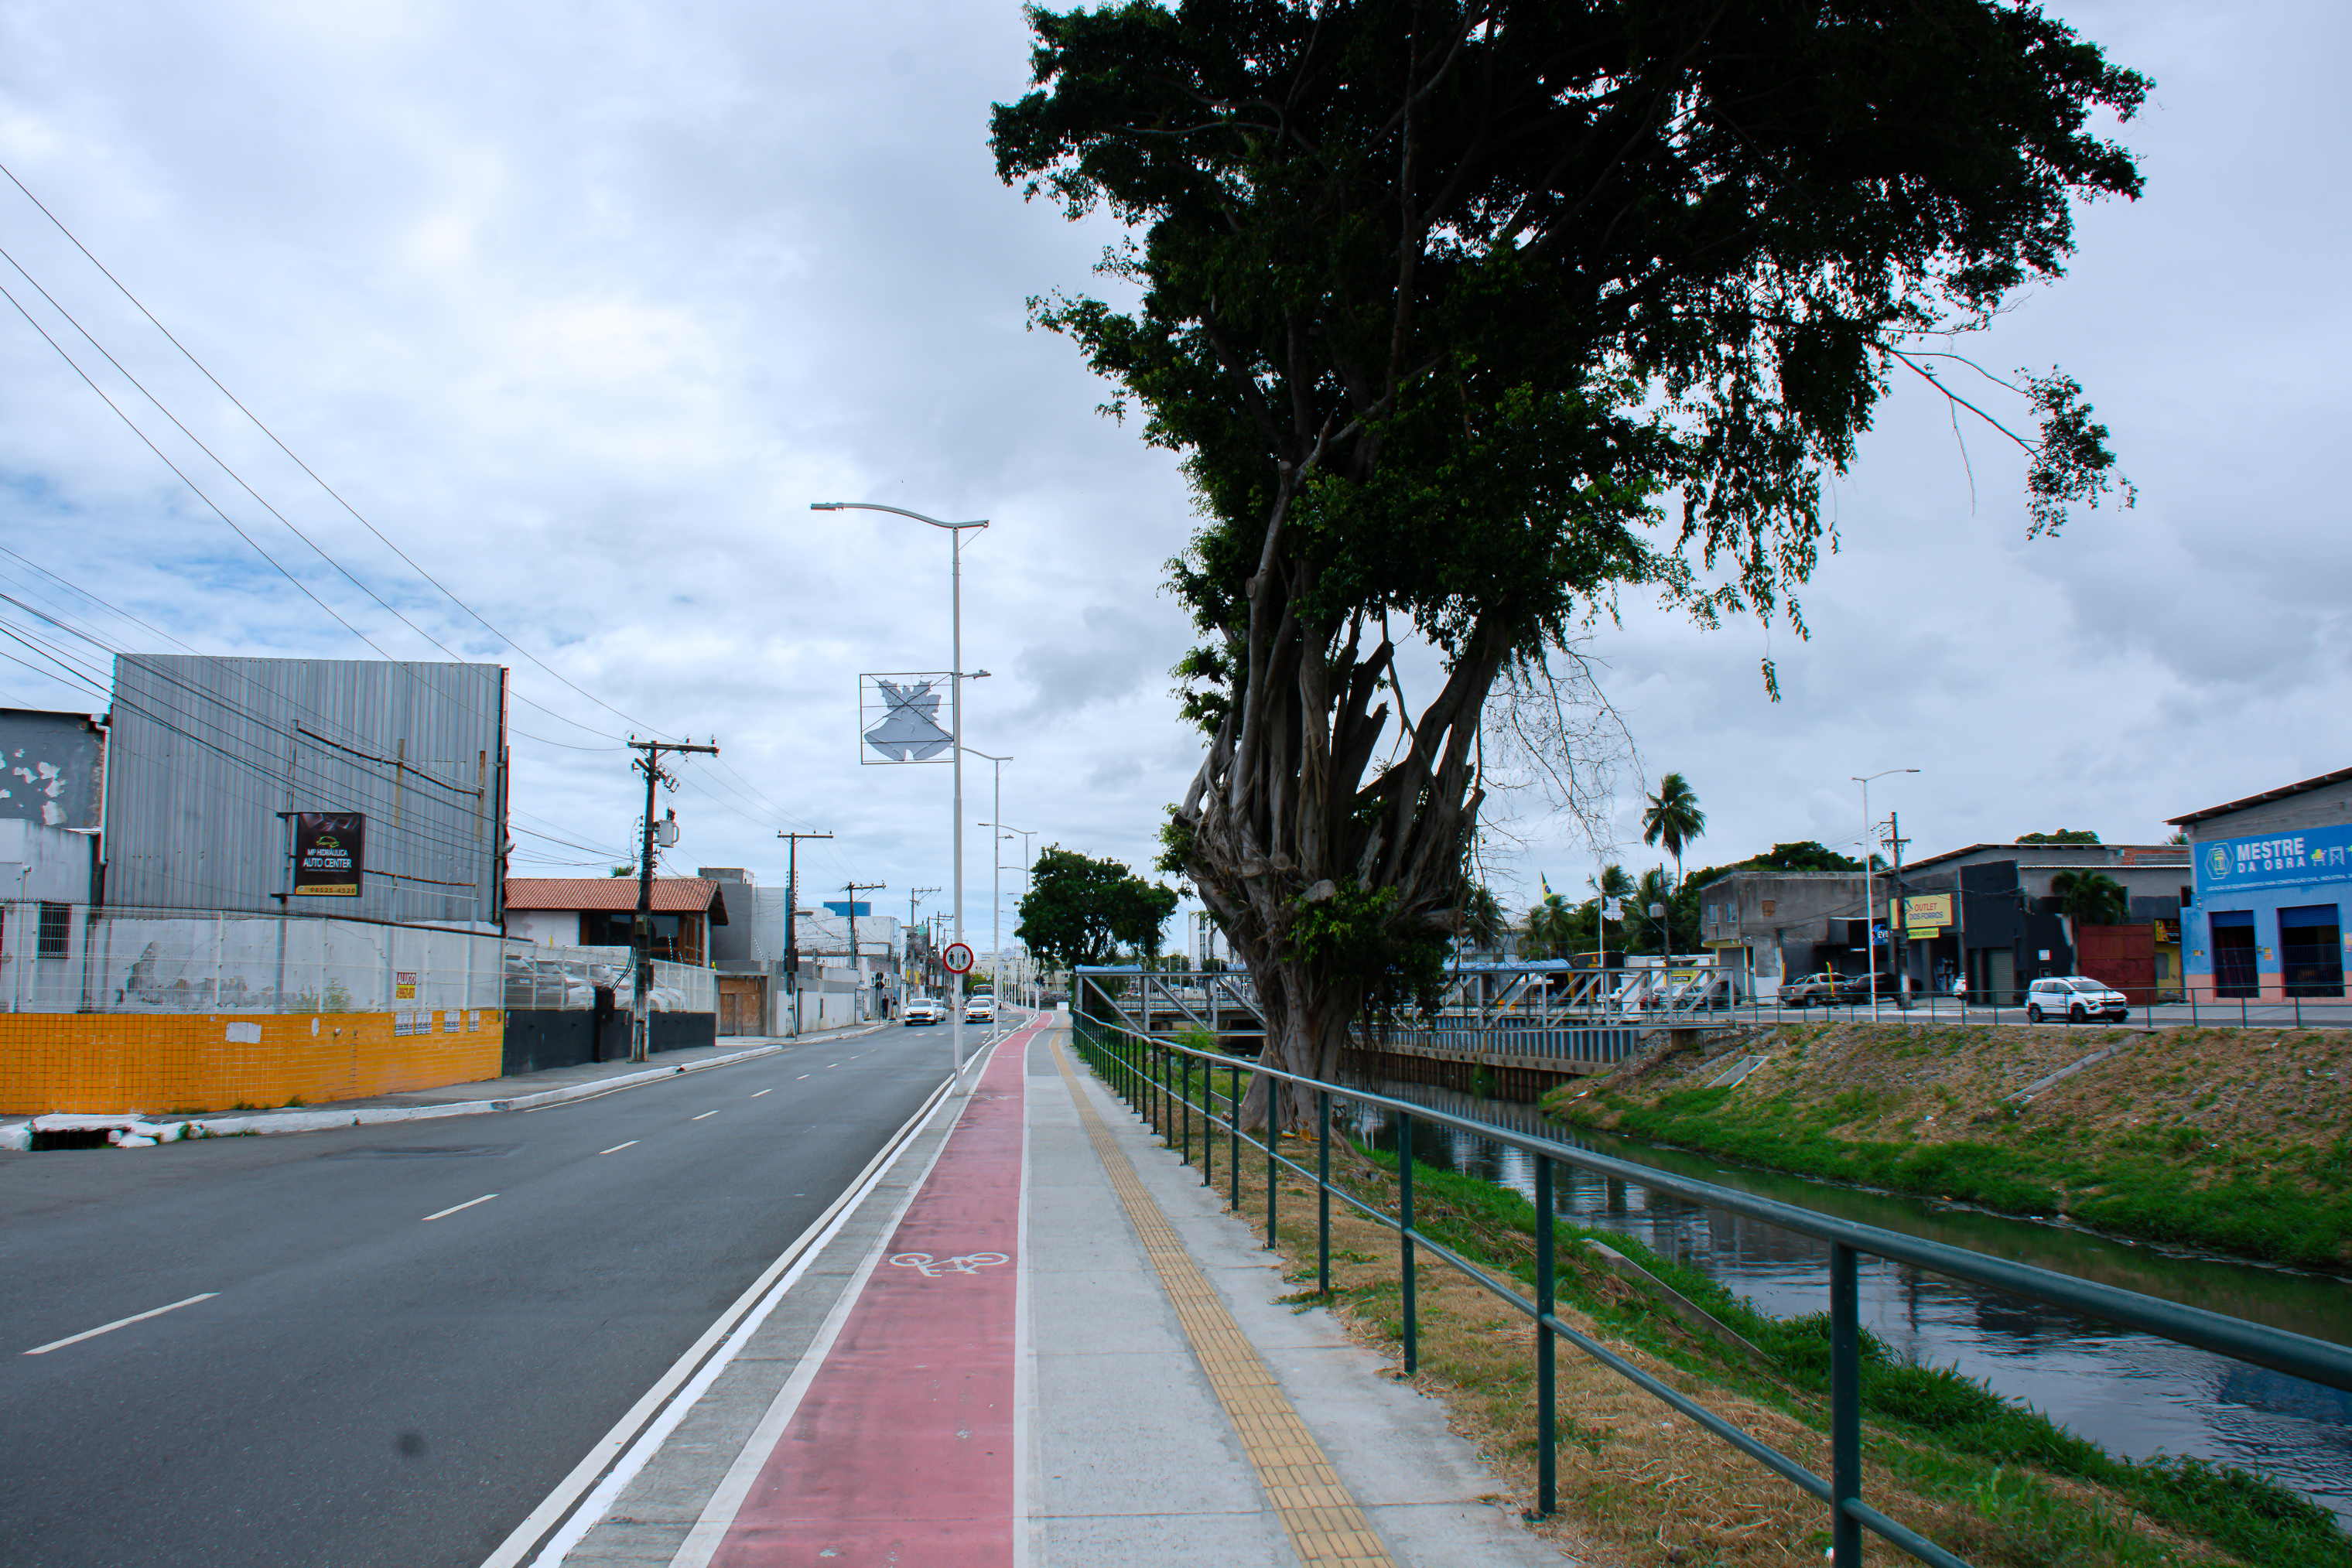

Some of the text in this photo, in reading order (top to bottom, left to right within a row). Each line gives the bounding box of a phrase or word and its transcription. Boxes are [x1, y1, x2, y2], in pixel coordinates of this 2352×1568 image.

[316, 847, 348, 856] HIDRÁULICA
[2236, 837, 2305, 861] MESTRE
[303, 858, 352, 868] AUTO CENTER
[2237, 856, 2306, 873] DA OBRA
[1914, 903, 1937, 911] OUTLET
[1920, 911, 1943, 920] FORROS
[398, 973, 415, 985] ALUGO
